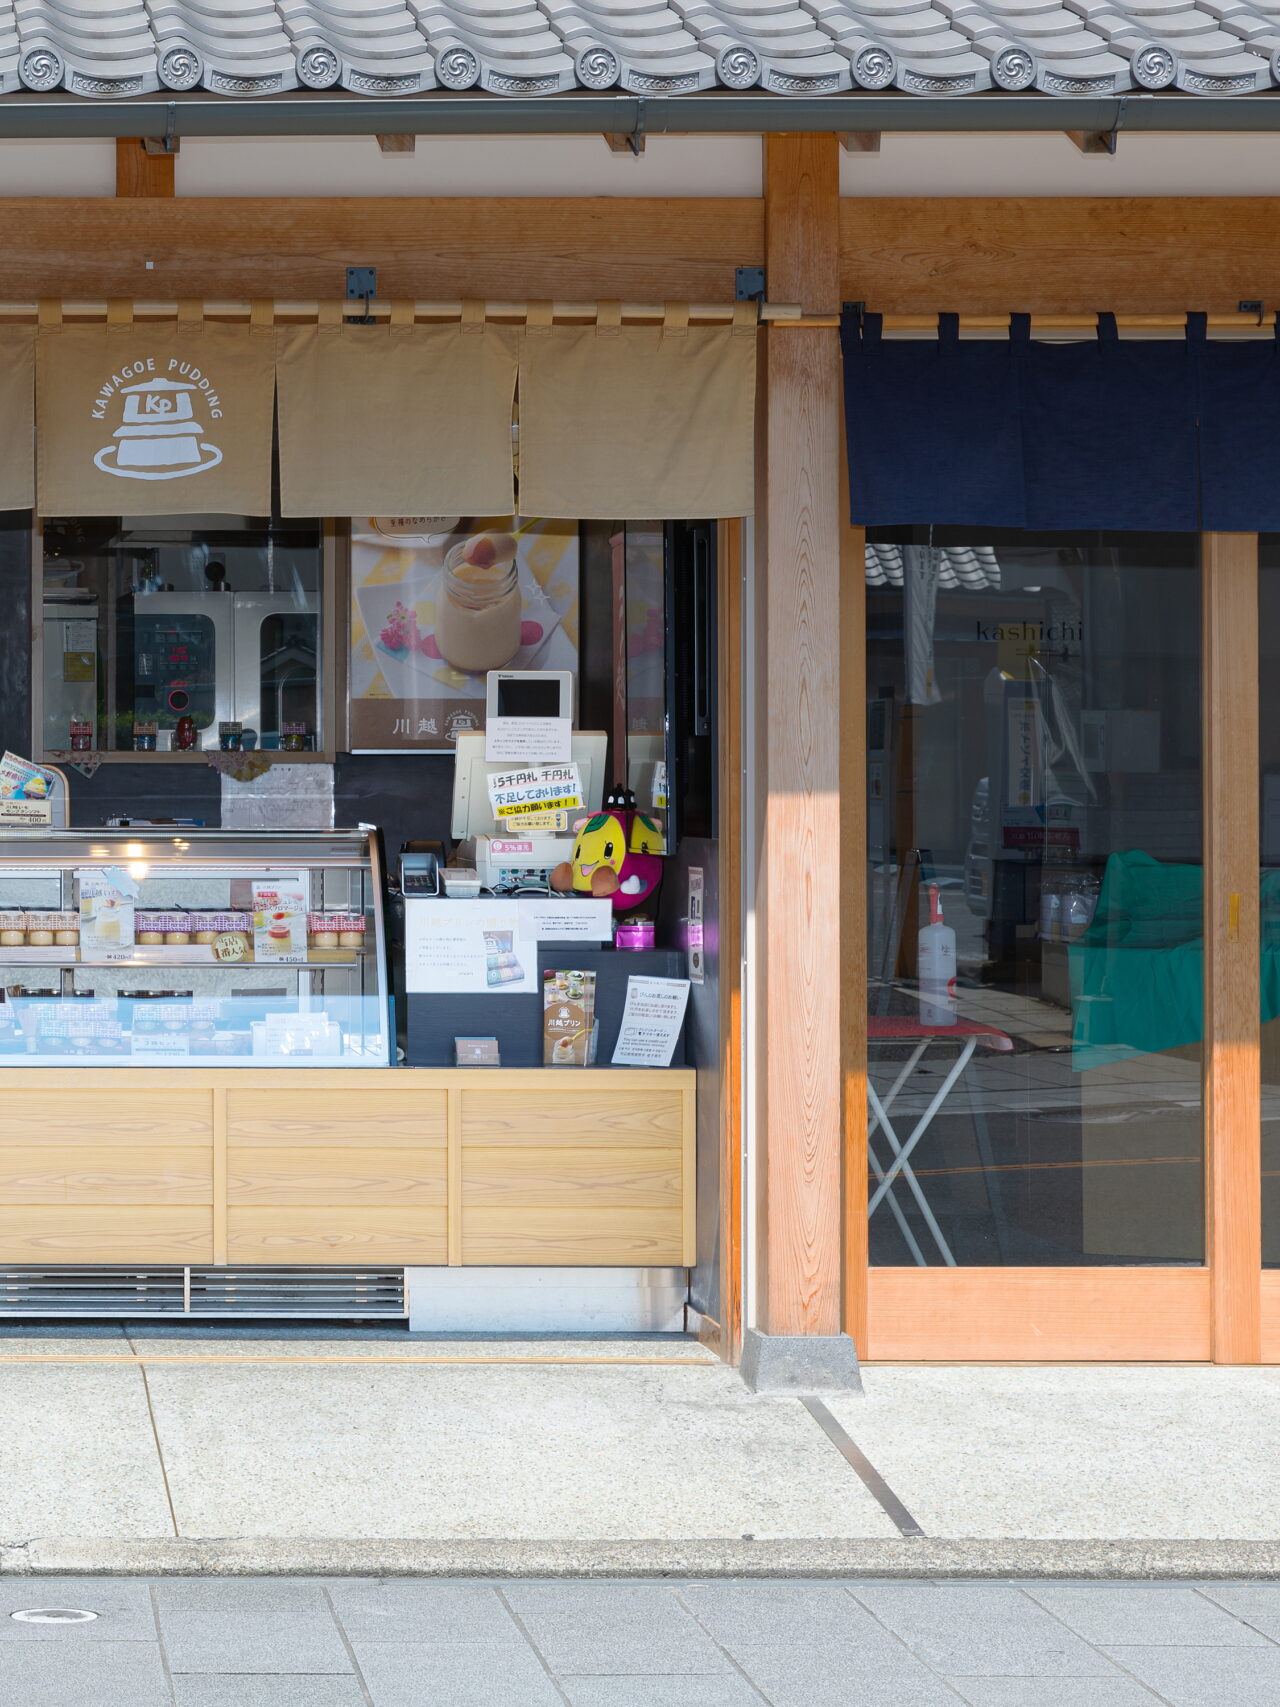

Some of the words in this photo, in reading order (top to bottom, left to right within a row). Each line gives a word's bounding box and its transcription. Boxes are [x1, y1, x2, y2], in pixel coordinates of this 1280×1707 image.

[91, 358, 156, 419] KAWAGOE
[167, 358, 223, 419] PUDDING
[976, 621, 1084, 641] kashichi
[392, 718, 438, 735] 川越
[541, 769, 573, 780] 千円札
